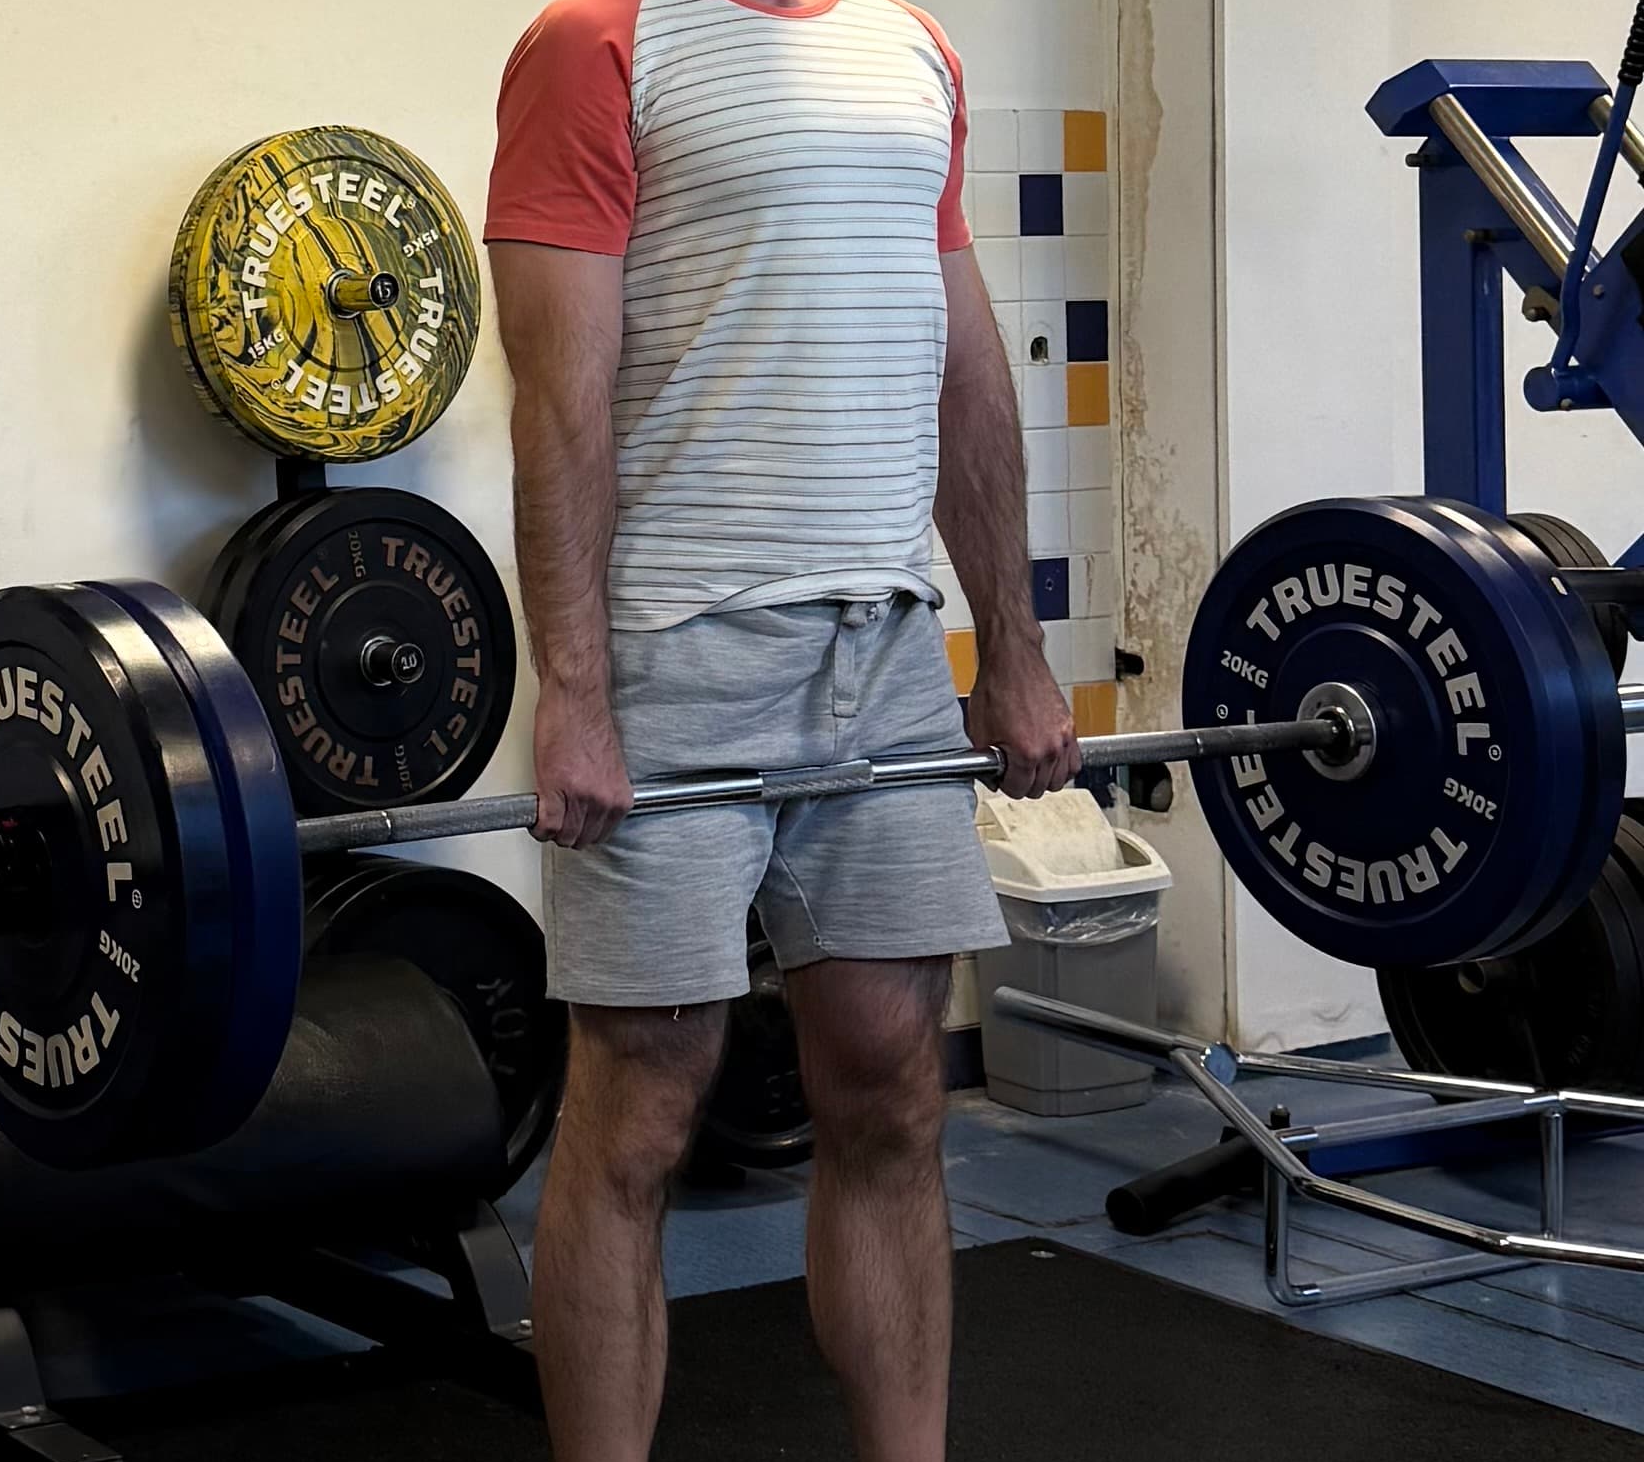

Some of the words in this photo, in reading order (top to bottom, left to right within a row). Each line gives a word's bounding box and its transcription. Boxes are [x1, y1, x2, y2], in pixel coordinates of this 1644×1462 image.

[241, 172, 406, 320] TRUESTEEL
[402, 228, 439, 259] 15KG
[247, 328, 286, 360] 15KG
[285, 267, 445, 415] TRUESTEEL
[276, 565, 380, 788] TRUESTEEL
[1220, 650, 1269, 690] 20KG
[1246, 563, 1491, 756] TRUESTEEL
[1443, 777, 1498, 820] 20KG
[98, 929, 142, 983] 20KG
